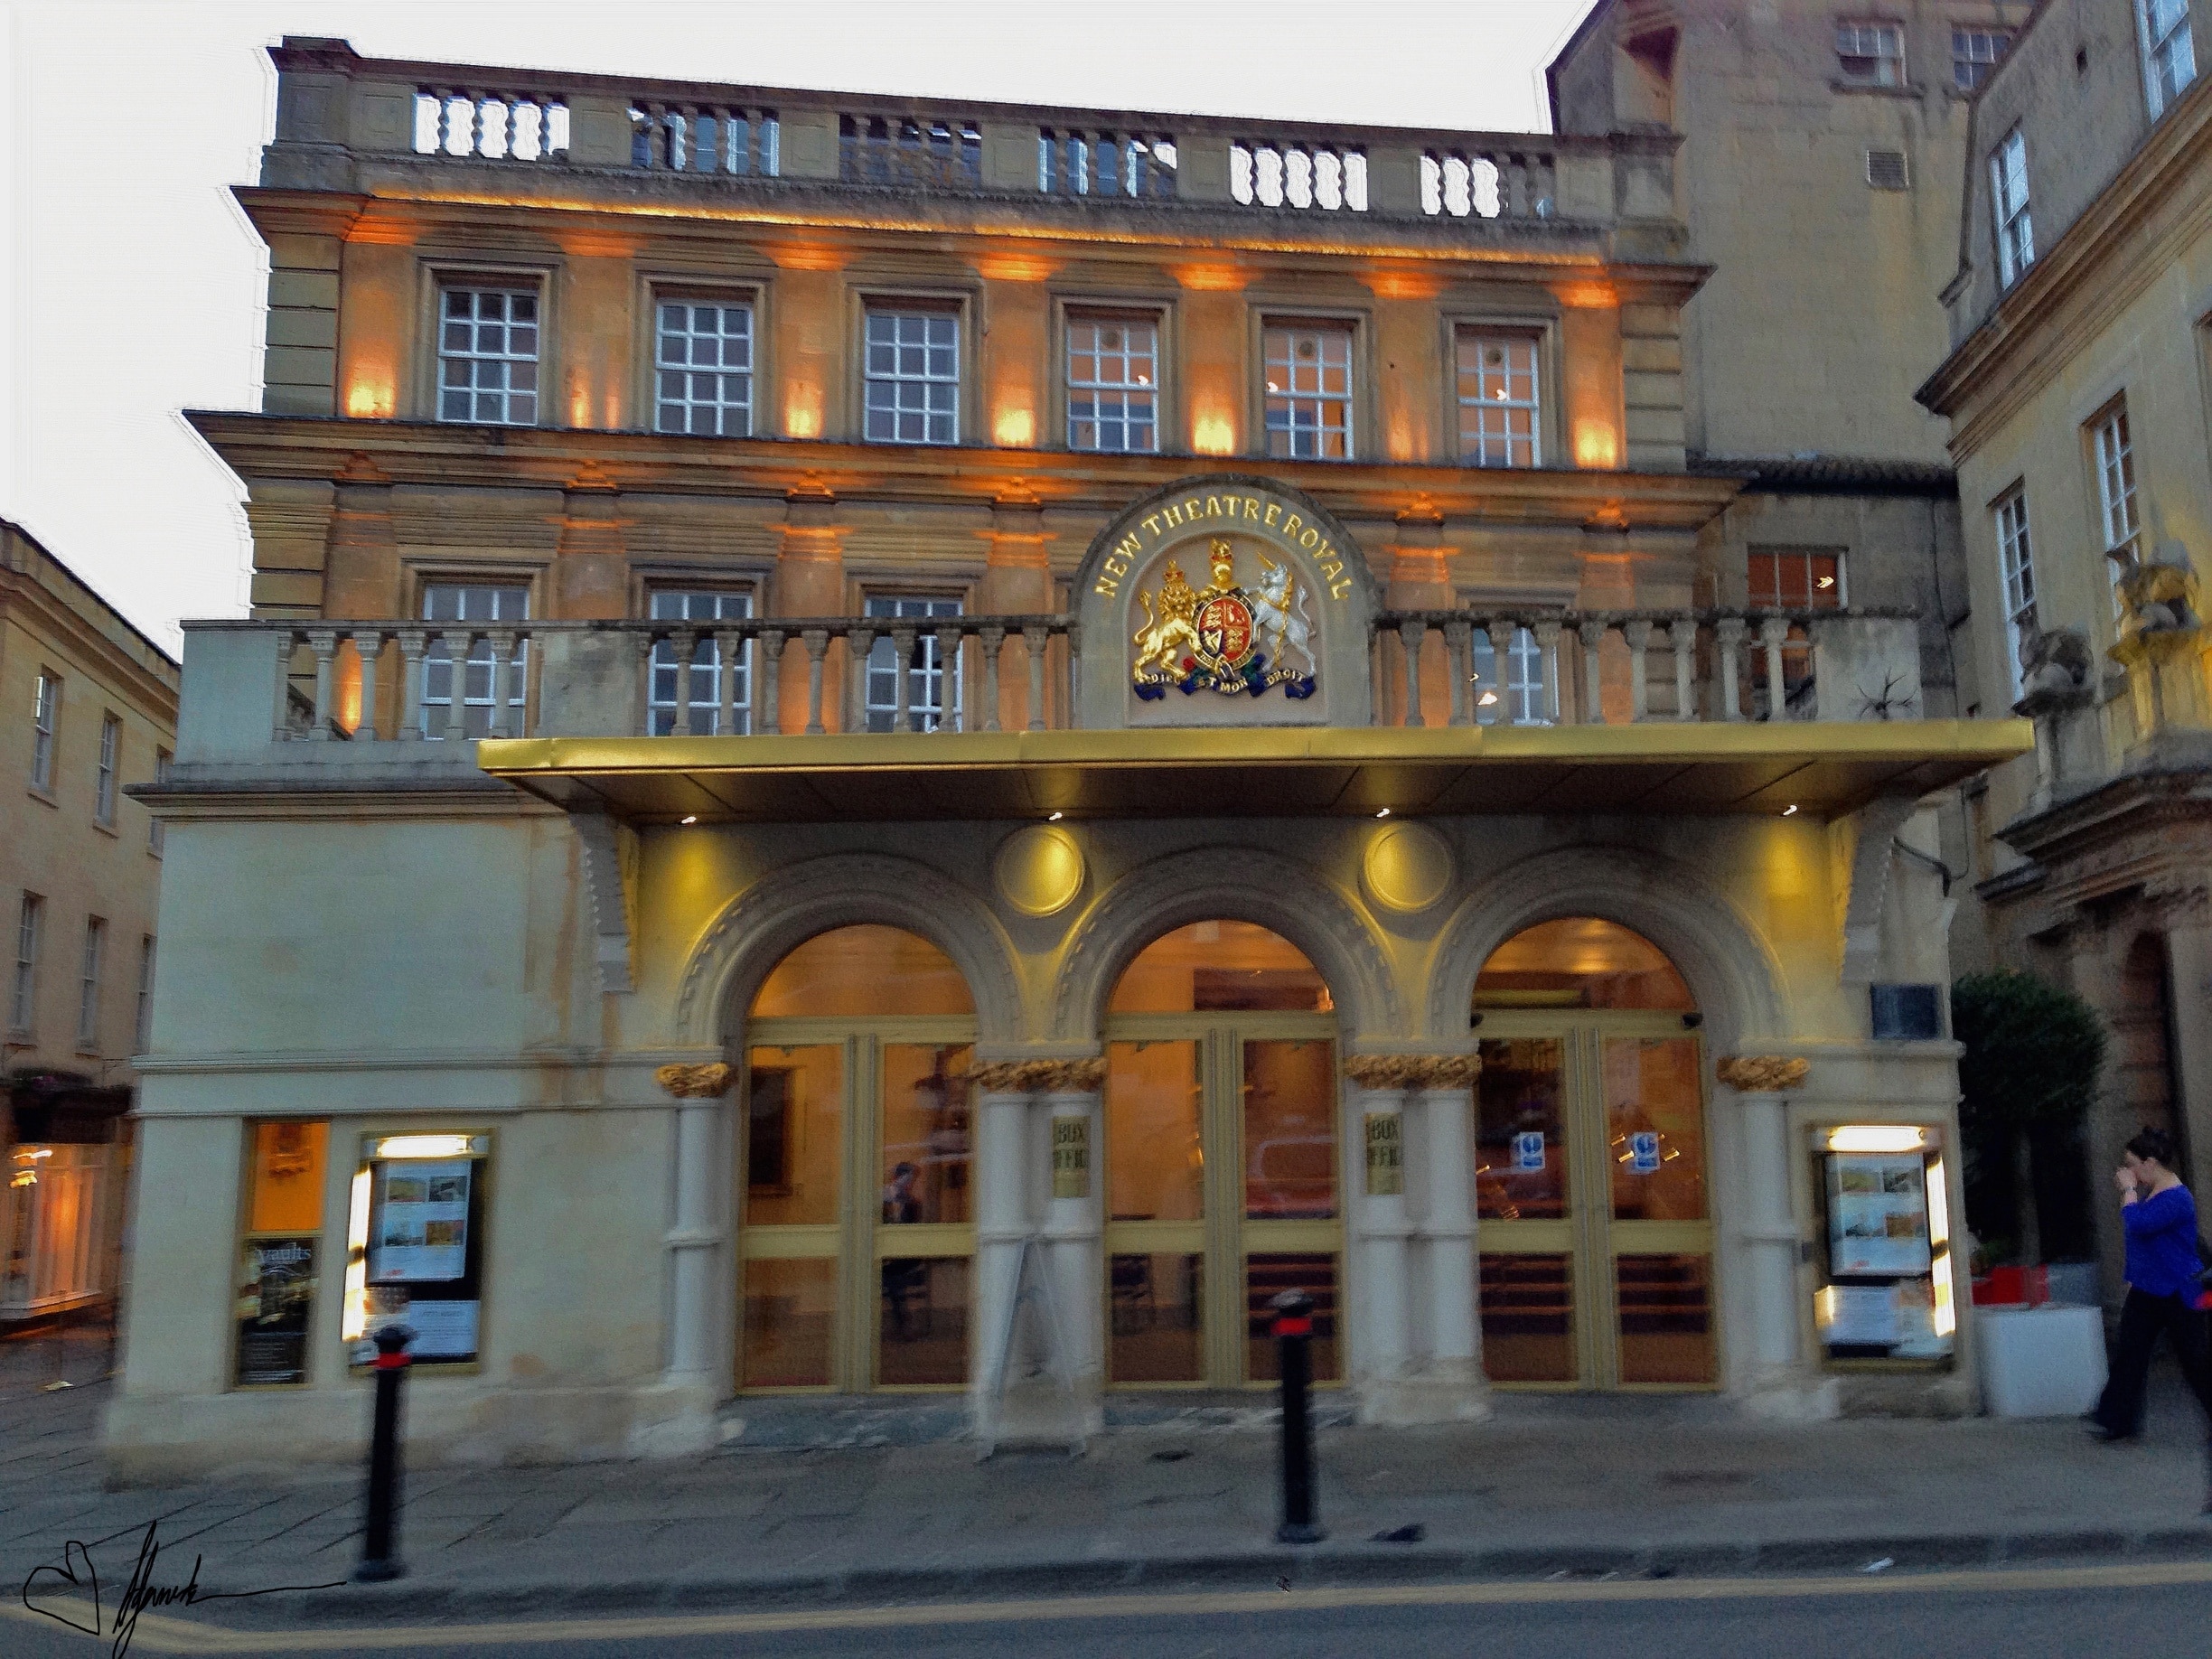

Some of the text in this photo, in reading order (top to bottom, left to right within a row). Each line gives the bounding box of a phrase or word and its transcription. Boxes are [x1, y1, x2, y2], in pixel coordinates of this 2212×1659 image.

[1092, 493, 1354, 601] NEW THEATRE ROYAL
[1220, 678, 1248, 693] MON
[1266, 669, 1306, 686] DROIT
[1058, 1122, 1085, 1143] BOX
[1372, 1120, 1399, 1140] BOX
